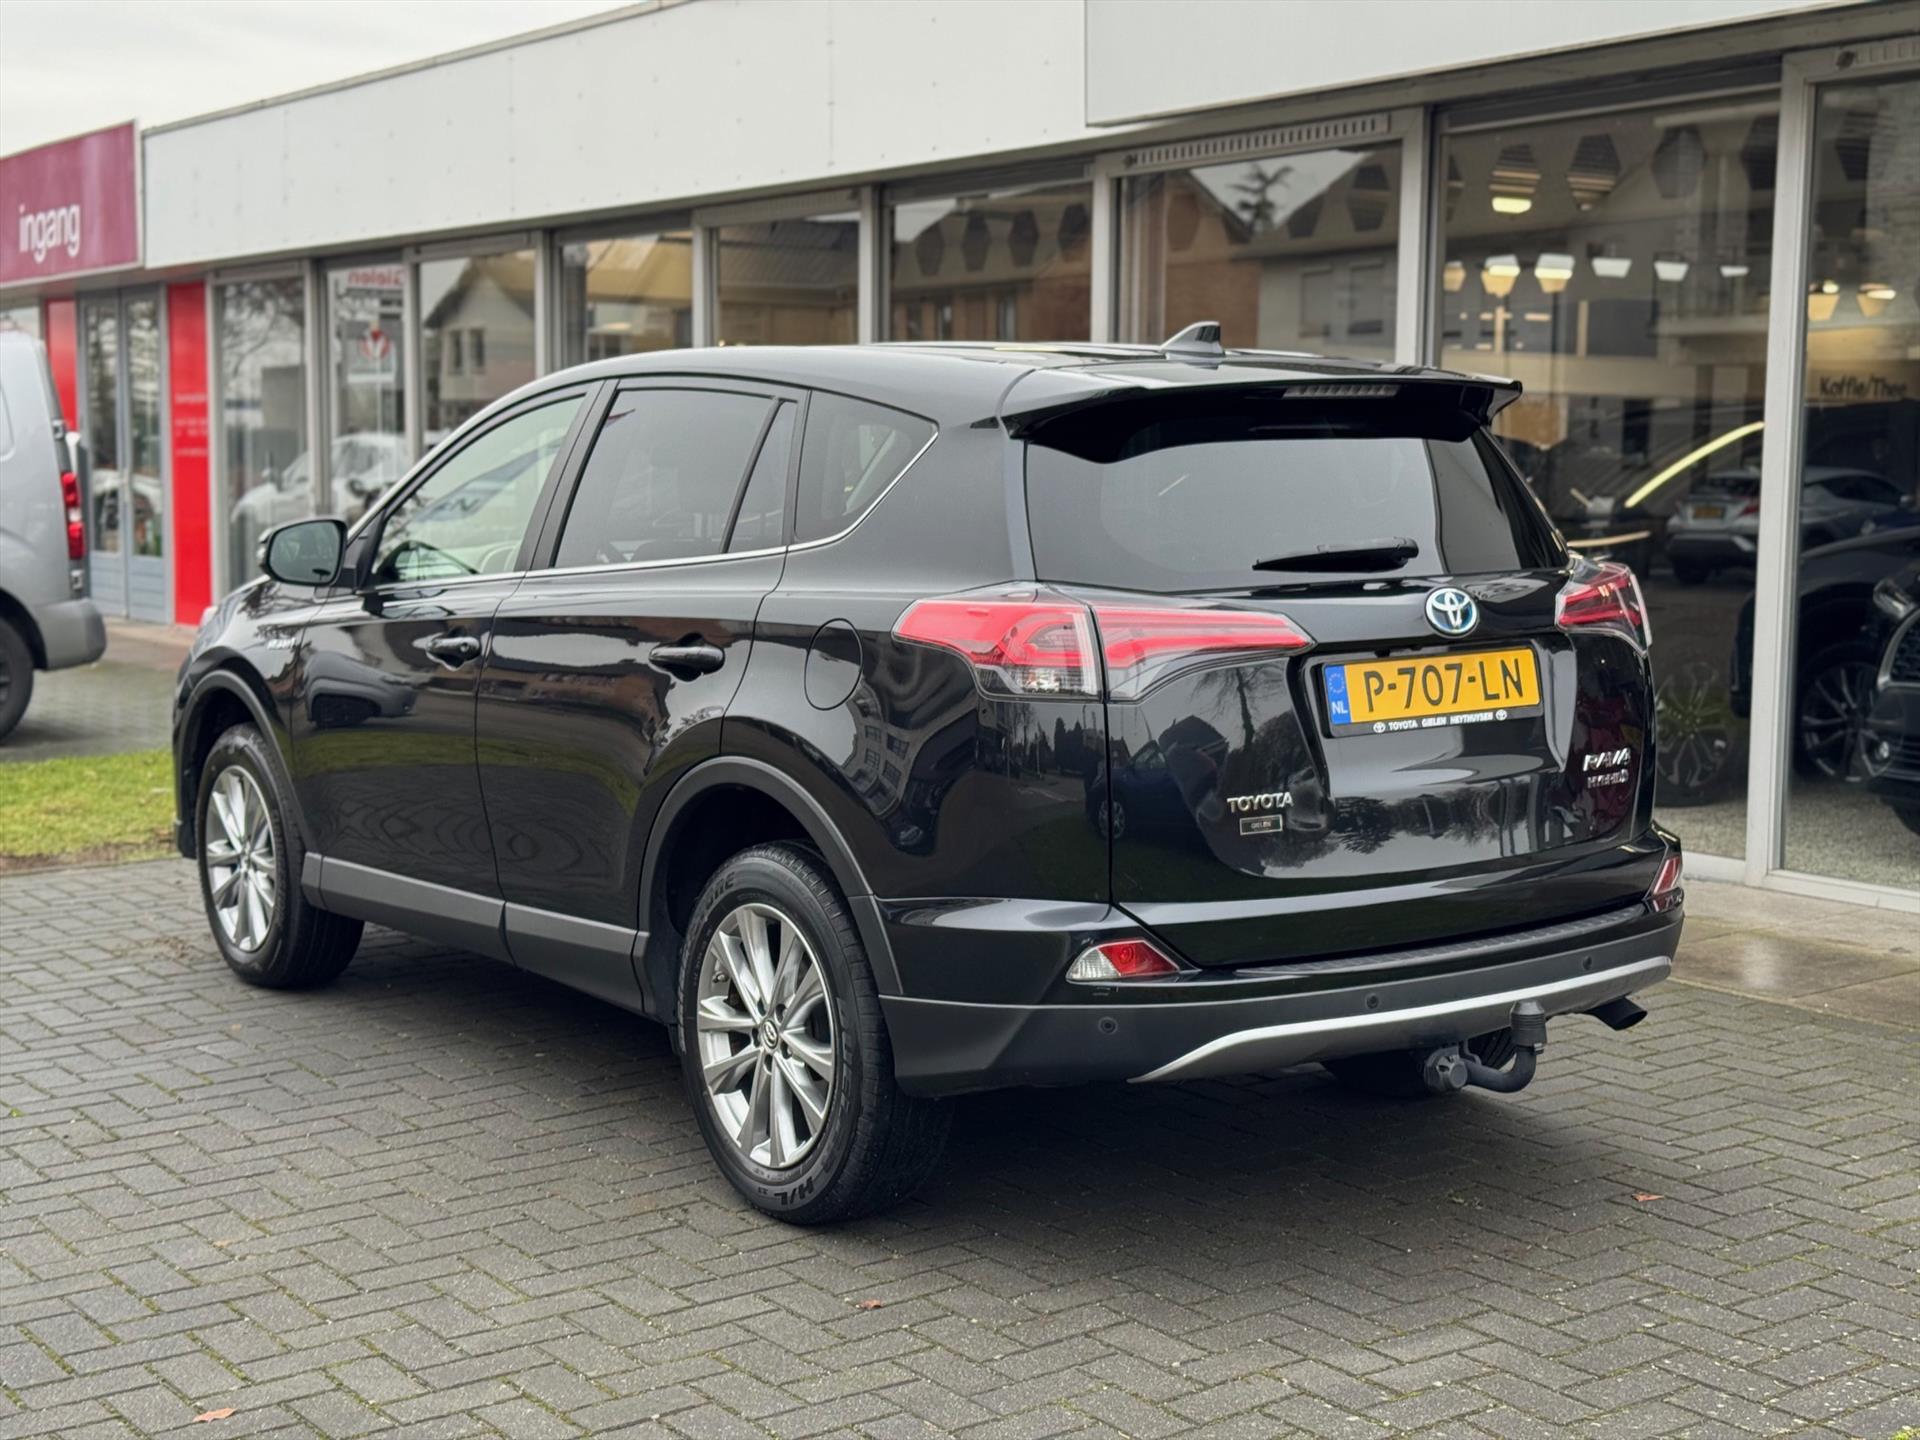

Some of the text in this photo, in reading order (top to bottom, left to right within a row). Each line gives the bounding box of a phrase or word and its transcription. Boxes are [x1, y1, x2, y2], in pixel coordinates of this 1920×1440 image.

[18, 203, 80, 263] ingang
[1363, 658, 1524, 713] P-707-LN
[1331, 701, 1348, 715] NL
[1388, 719, 1418, 731] TOYOTA
[1421, 716, 1447, 728] GIELEN
[1226, 791, 1295, 813] TOYOTA
